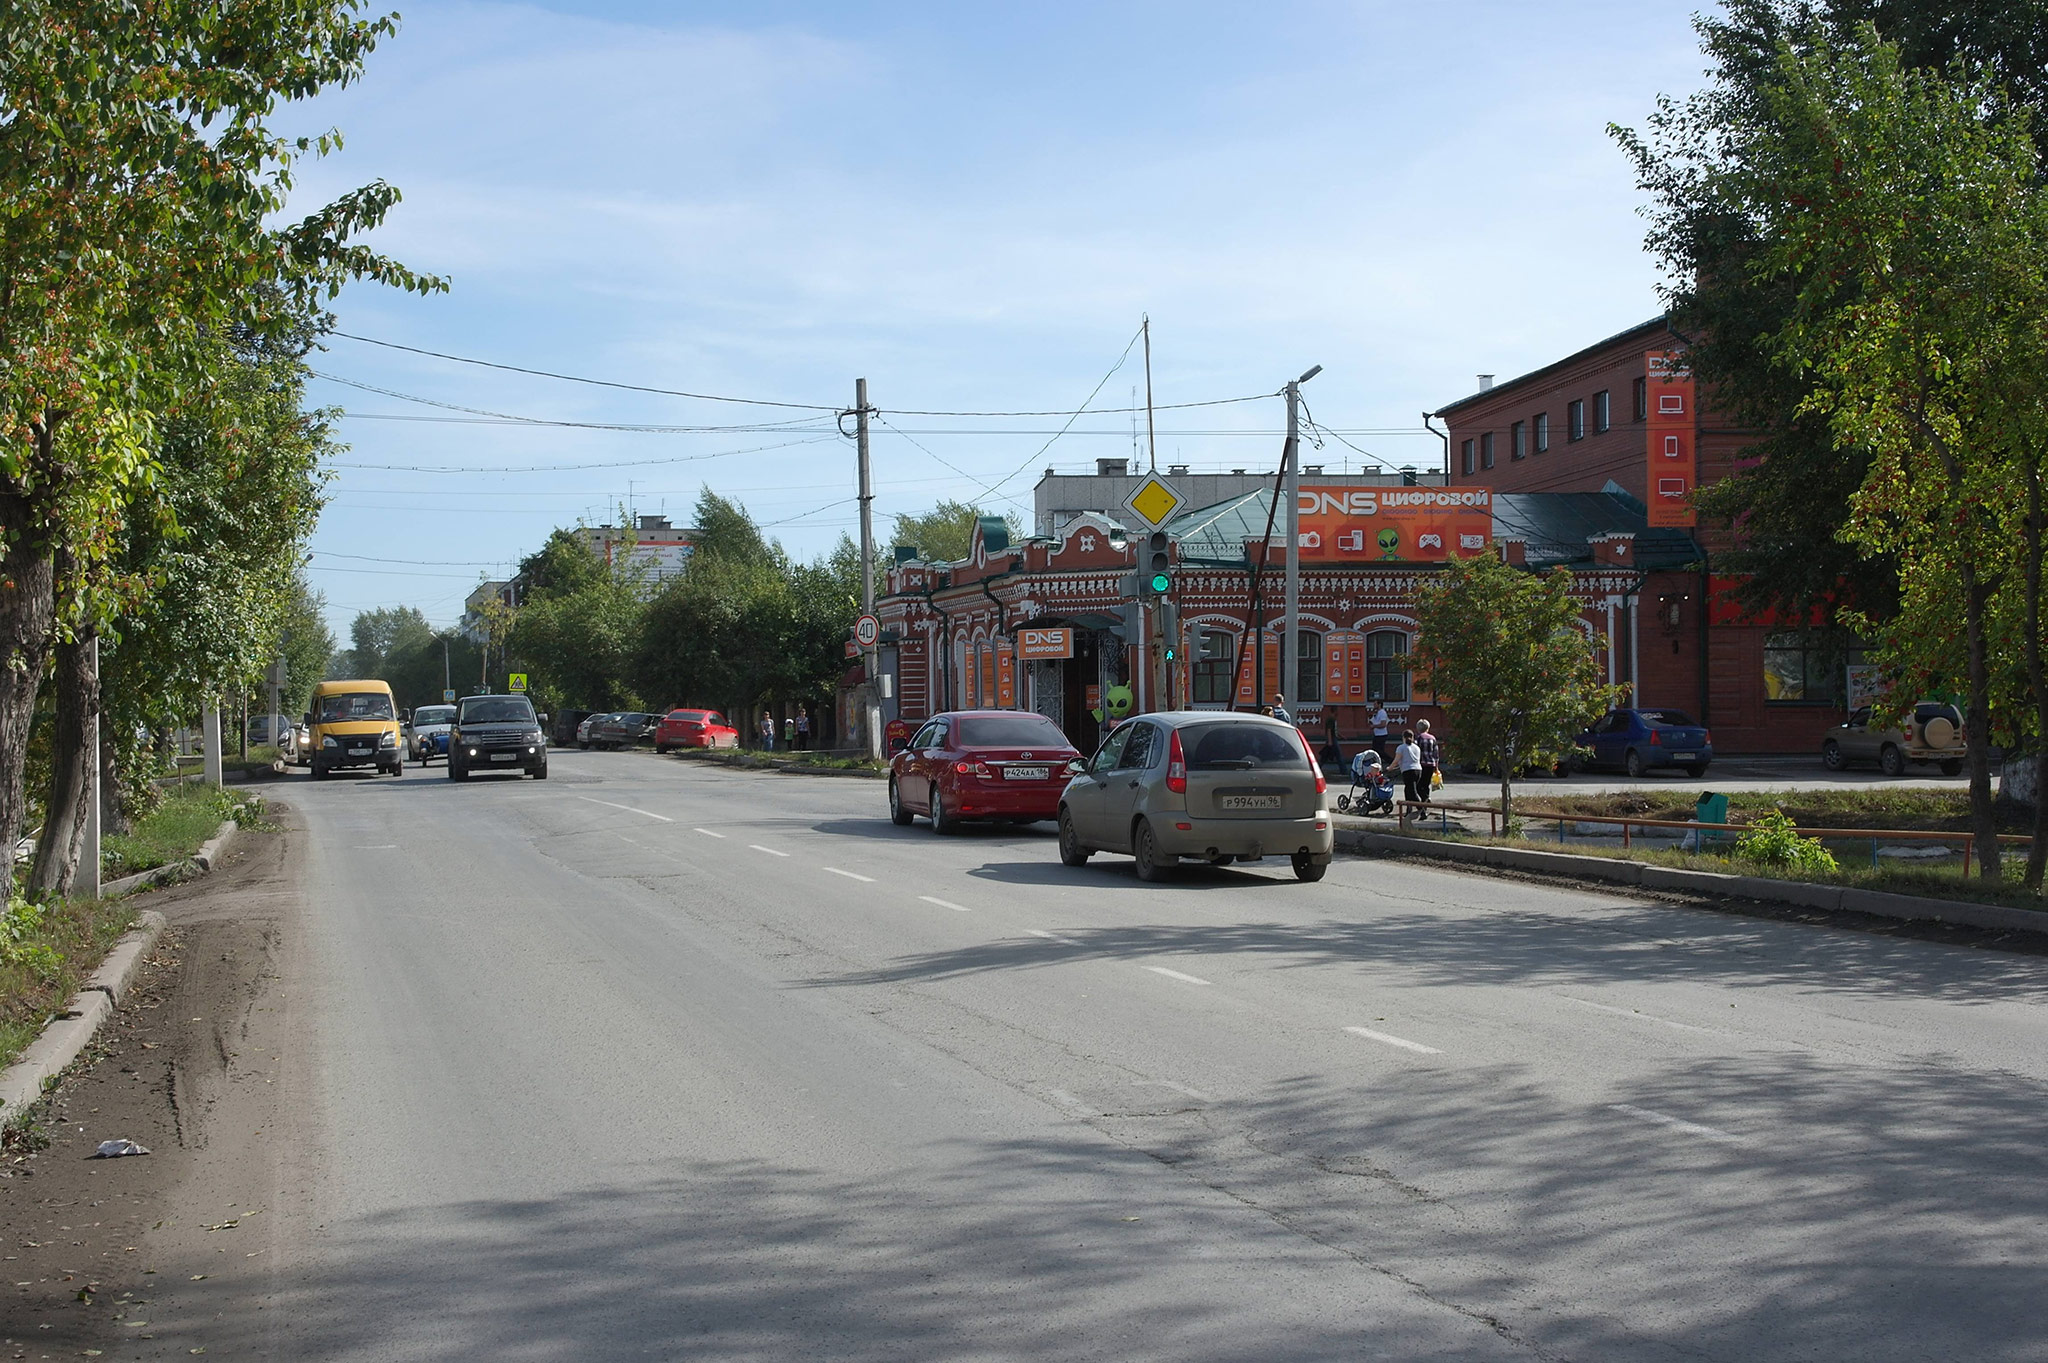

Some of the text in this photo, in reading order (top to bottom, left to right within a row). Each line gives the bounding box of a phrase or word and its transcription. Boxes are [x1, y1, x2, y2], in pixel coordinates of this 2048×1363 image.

[1298, 492, 1377, 515] DNS
[1382, 490, 1488, 507] ЦИФРОВОЙ
[858, 623, 873, 639] 40
[1025, 631, 1064, 645] DNS
[1226, 796, 1278, 808] Р994УН 96
